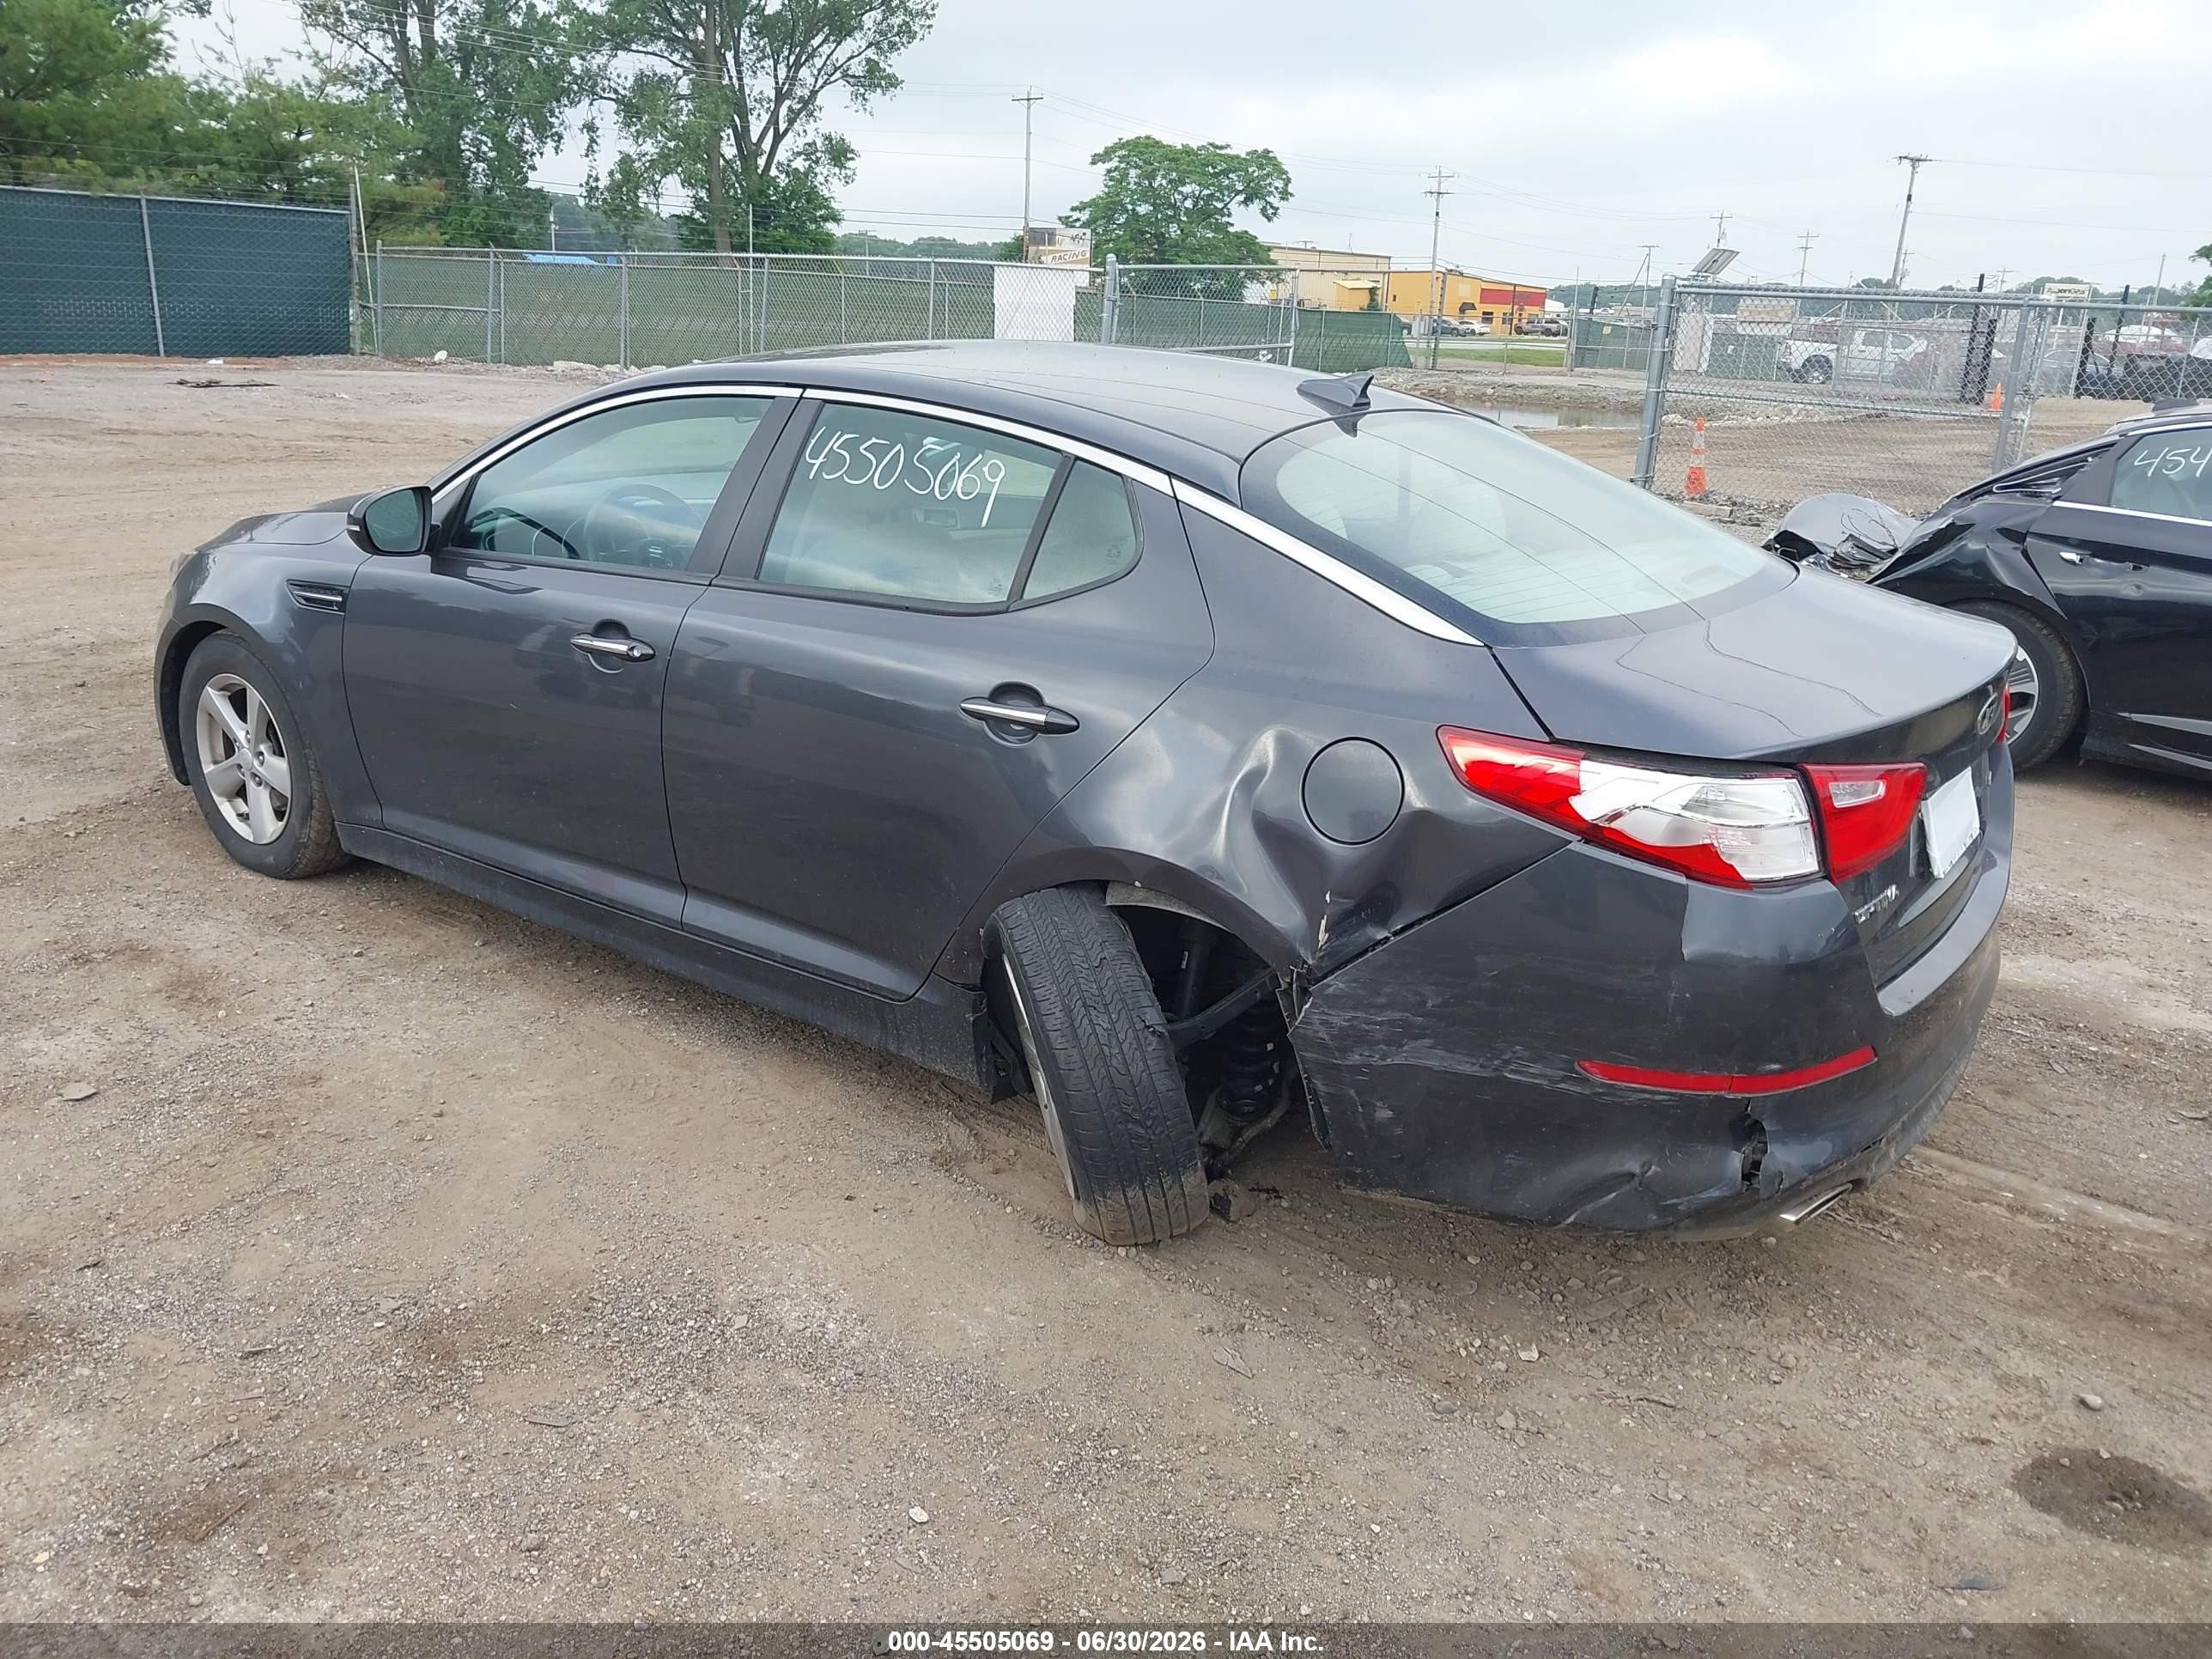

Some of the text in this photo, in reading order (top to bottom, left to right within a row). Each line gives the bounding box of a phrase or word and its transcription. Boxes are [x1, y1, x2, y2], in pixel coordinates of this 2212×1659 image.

[1050, 250, 1086, 263] RACING
[805, 426, 1006, 529] 45505069
[2133, 446, 2212, 479] 454
